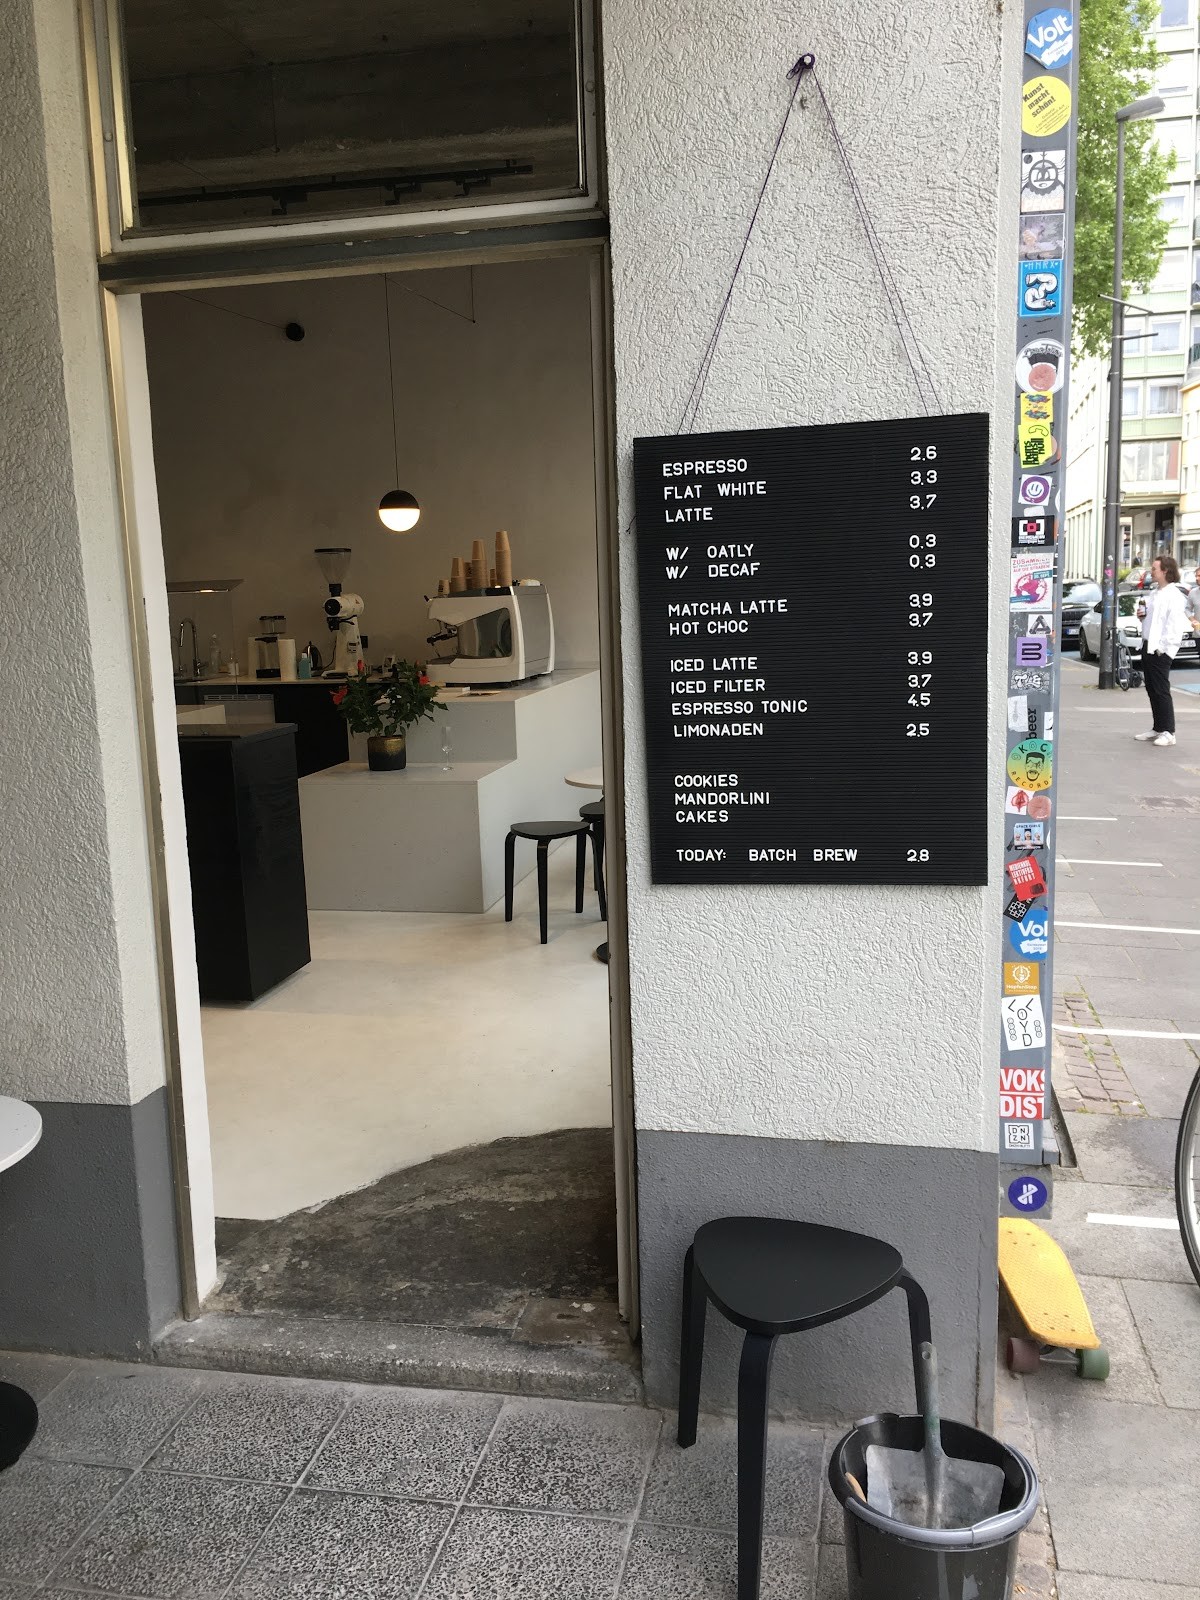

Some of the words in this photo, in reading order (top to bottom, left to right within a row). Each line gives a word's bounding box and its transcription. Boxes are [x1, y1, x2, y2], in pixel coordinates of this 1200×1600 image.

[1028, 14, 1072, 48] Volt
[1022, 83, 1045, 102] Kunst
[1028, 90, 1050, 110] macht
[662, 458, 748, 478] ESPRESSO
[910, 445, 938, 462] 2.6
[663, 484, 703, 501] FLAT
[717, 480, 767, 497] WHITE
[910, 469, 938, 486] 3.3
[665, 507, 714, 523] LATTE
[909, 493, 937, 511] 3.7
[665, 546, 689, 561] W/
[706, 543, 754, 559] OATLY
[909, 533, 937, 550] 0.3
[665, 565, 689, 580] W/
[707, 561, 761, 578] DECAF
[909, 553, 936, 570] 0.3
[668, 601, 733, 618] MATCHA
[740, 598, 788, 615] LATTE
[909, 592, 933, 609] 3.9
[669, 621, 700, 637] HOT
[707, 619, 749, 635] CHOC
[908, 612, 934, 628] 3.7
[670, 658, 705, 673] ICED
[712, 656, 758, 671] LATTE
[907, 650, 933, 666] 3.9
[670, 680, 707, 696] ICED
[713, 678, 766, 693] FILTER
[907, 673, 932, 689] 3.7
[671, 700, 754, 716] ESPRESSO
[760, 699, 808, 714] TONIC
[907, 692, 931, 708] 4.5
[673, 722, 764, 739] LIMONADEN
[906, 722, 930, 738] 2.5
[1026, 708, 1037, 740] beer
[674, 773, 739, 789] COOKIES
[1011, 771, 1052, 788] RECORD
[674, 791, 770, 806] MANDORLINI
[675, 809, 729, 824] CAKES
[675, 848, 727, 862] TODAY:
[748, 848, 797, 862] BATCH
[813, 848, 858, 862] BREW
[906, 848, 930, 863] 2.8
